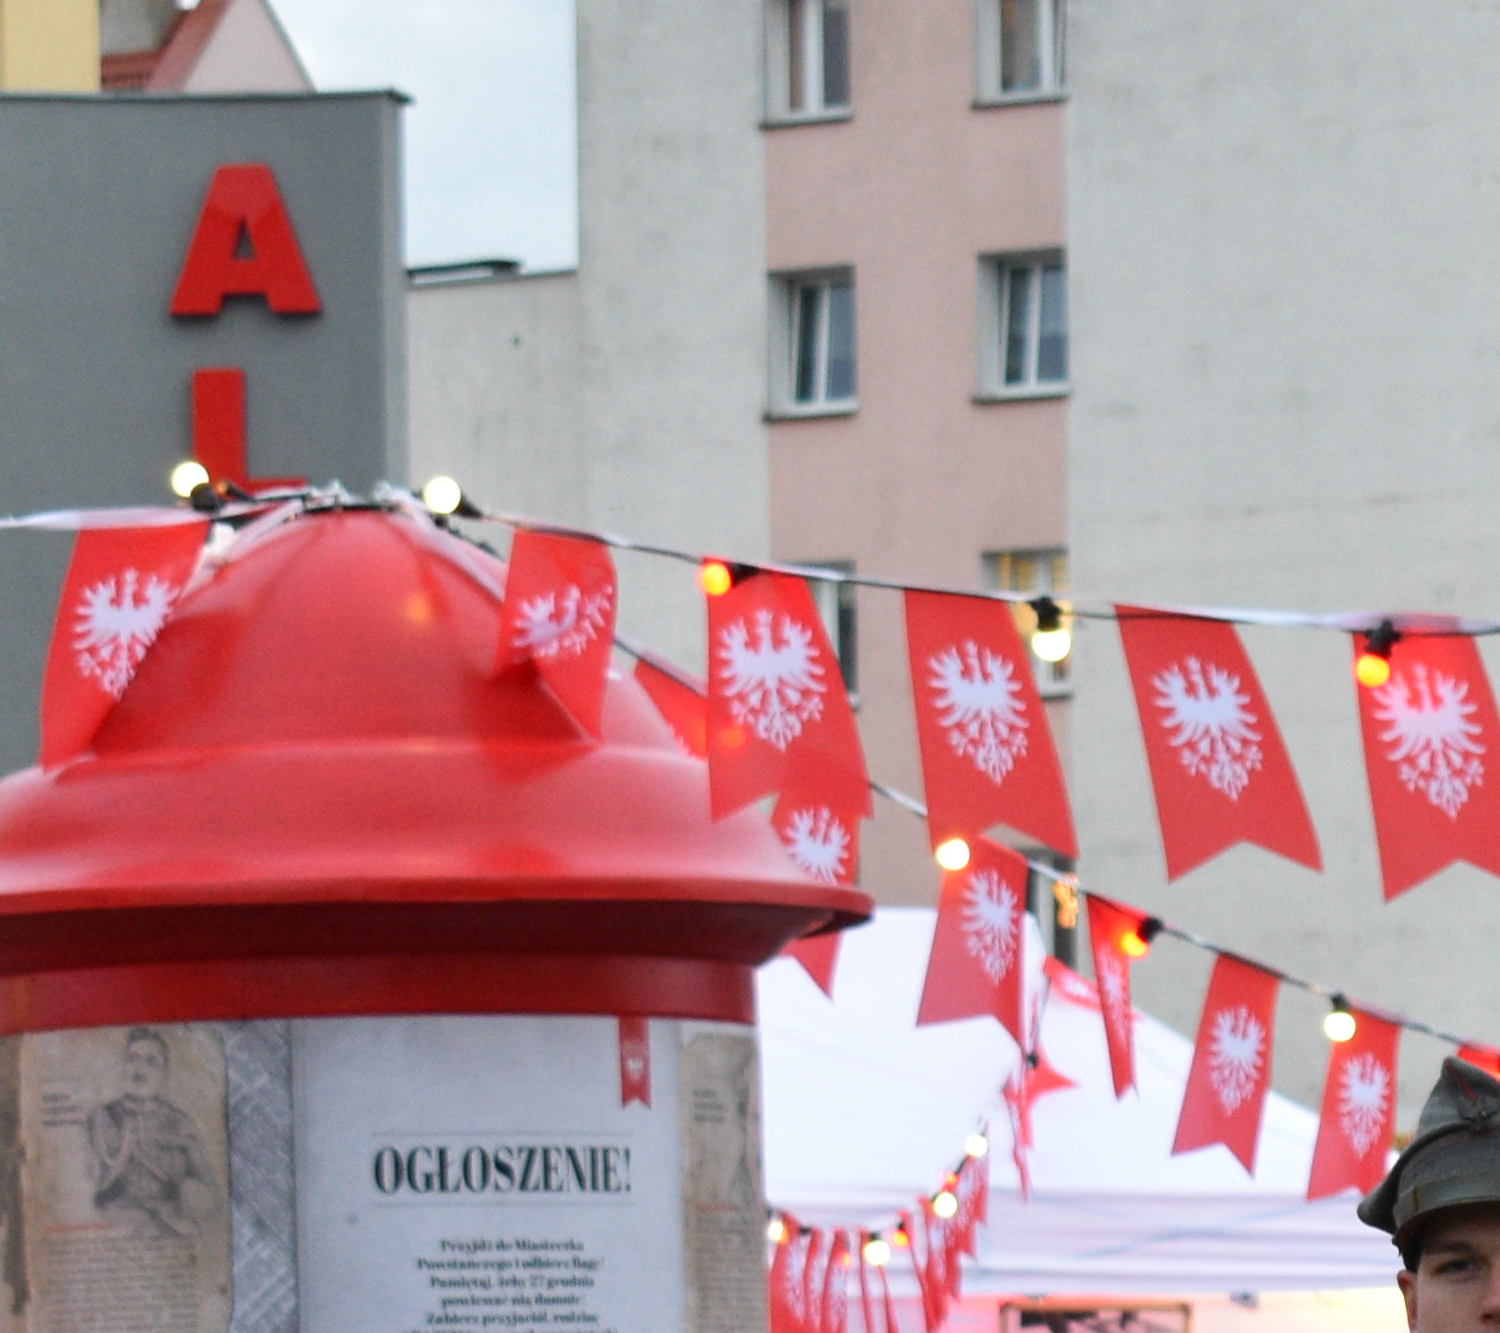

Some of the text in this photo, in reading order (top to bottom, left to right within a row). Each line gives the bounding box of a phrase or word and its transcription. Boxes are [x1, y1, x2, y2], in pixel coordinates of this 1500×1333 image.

[373, 1145, 632, 1194] OGŁOSZENIE!
[495, 1239, 512, 1251] do
[514, 1239, 585, 1252] Miasteczka
[546, 1275, 595, 1291] grudnia
[426, 1311, 480, 1325] Zabierz
